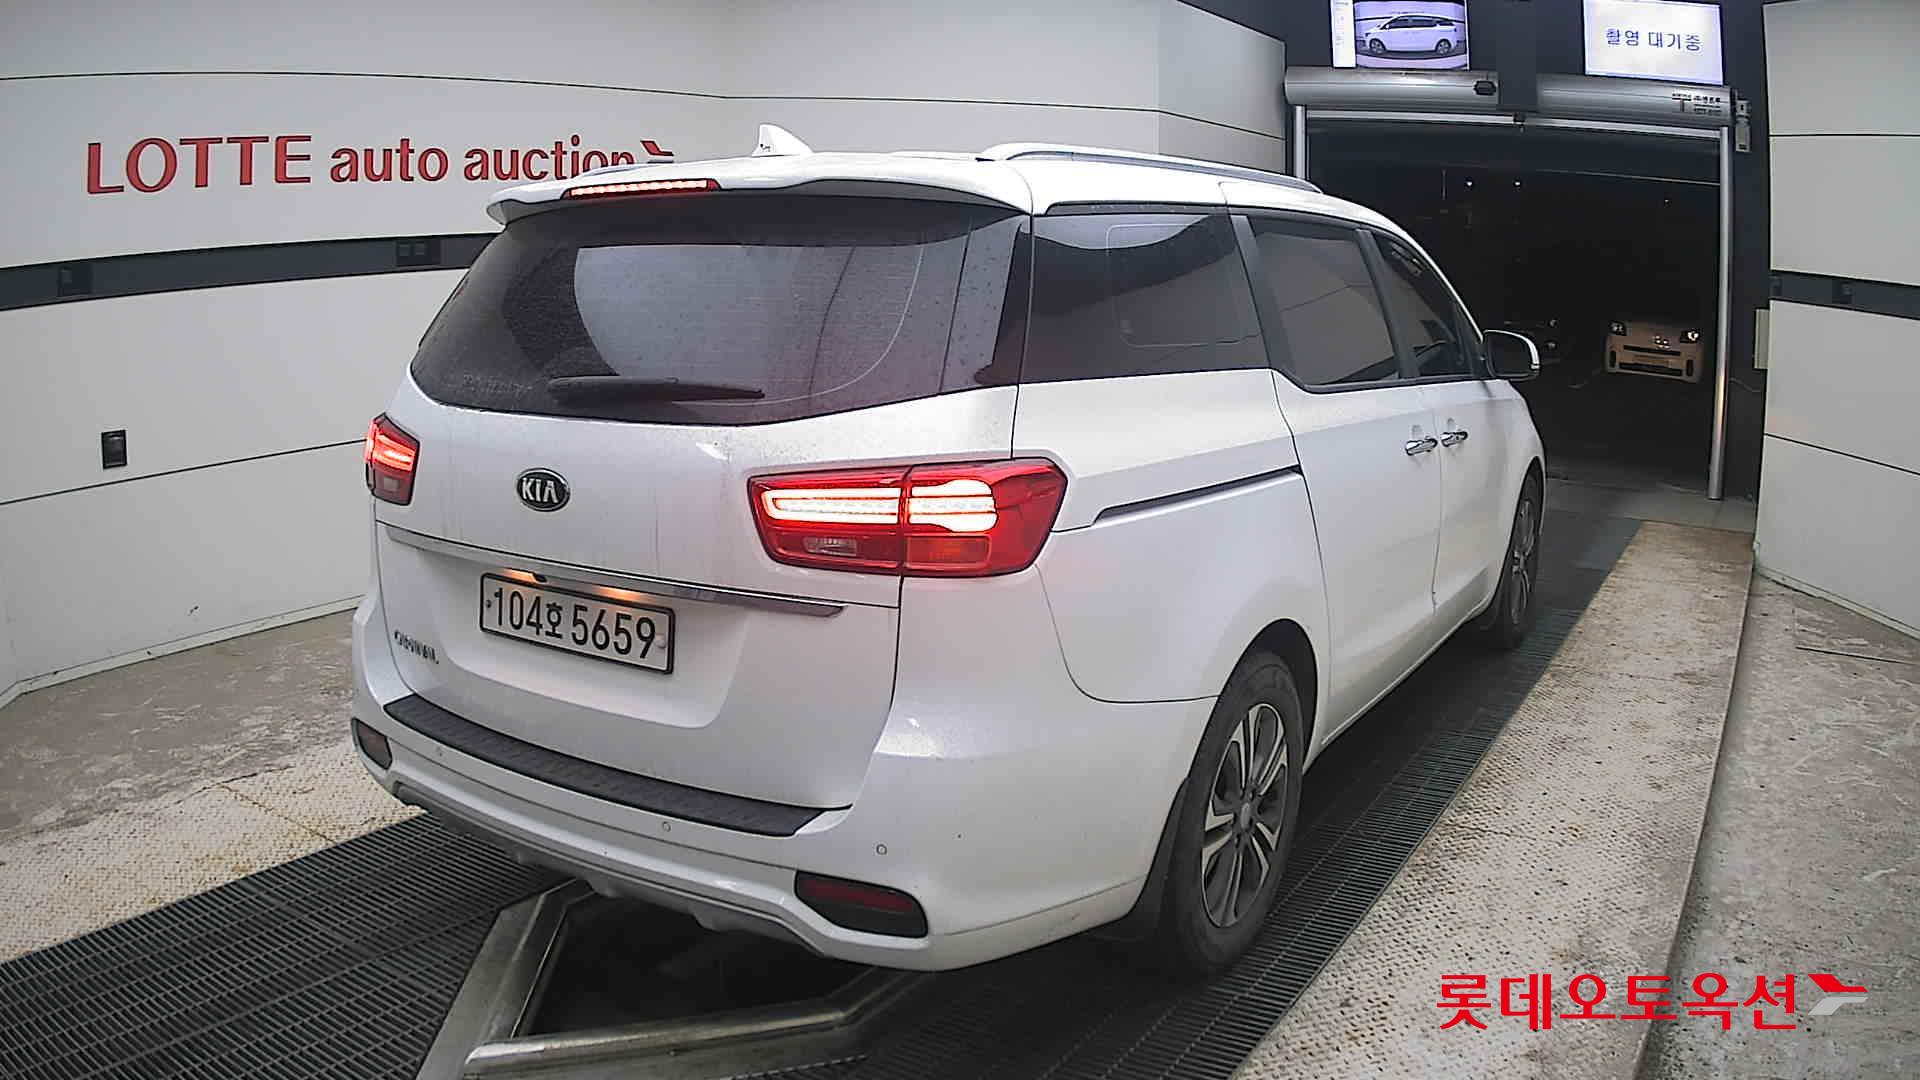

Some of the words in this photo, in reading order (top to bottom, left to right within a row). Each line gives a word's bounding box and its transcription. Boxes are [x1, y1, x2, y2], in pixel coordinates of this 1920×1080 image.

[1648, 31, 1701, 51] 대기중
[86, 135, 312, 194] LOTTE
[329, 137, 450, 183] auto
[522, 477, 559, 503] KIA
